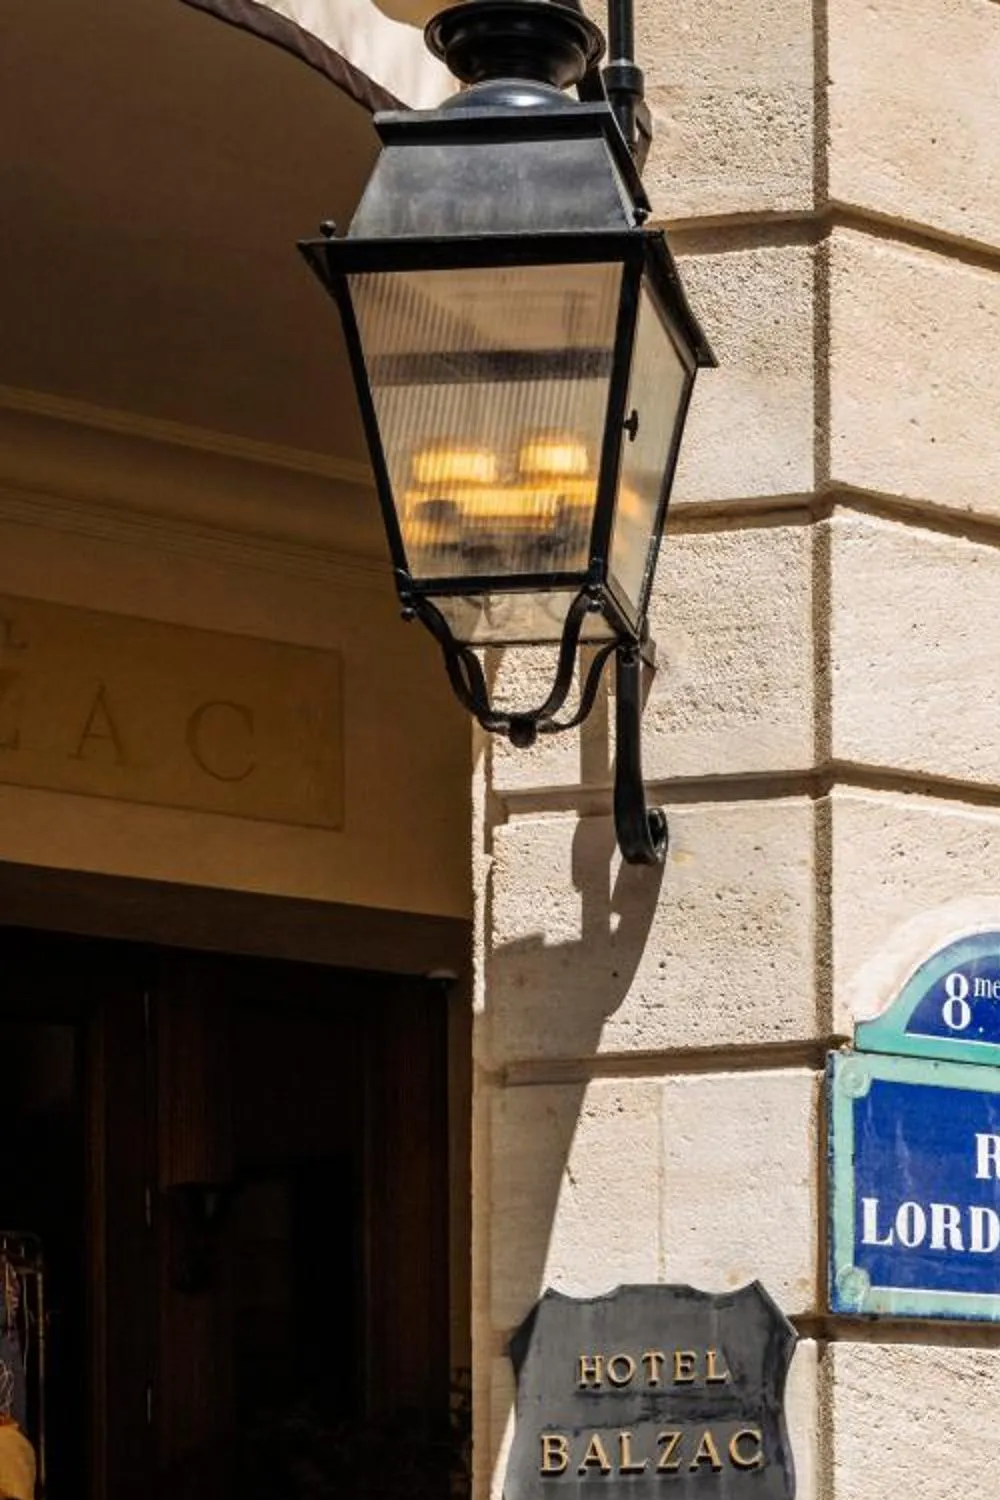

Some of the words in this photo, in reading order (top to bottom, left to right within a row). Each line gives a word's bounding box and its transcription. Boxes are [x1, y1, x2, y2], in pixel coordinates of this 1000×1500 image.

[861, 1198, 1000, 1253] LORD
[578, 1350, 730, 1388] HOTEL
[539, 1428, 766, 1476] BALZAC
